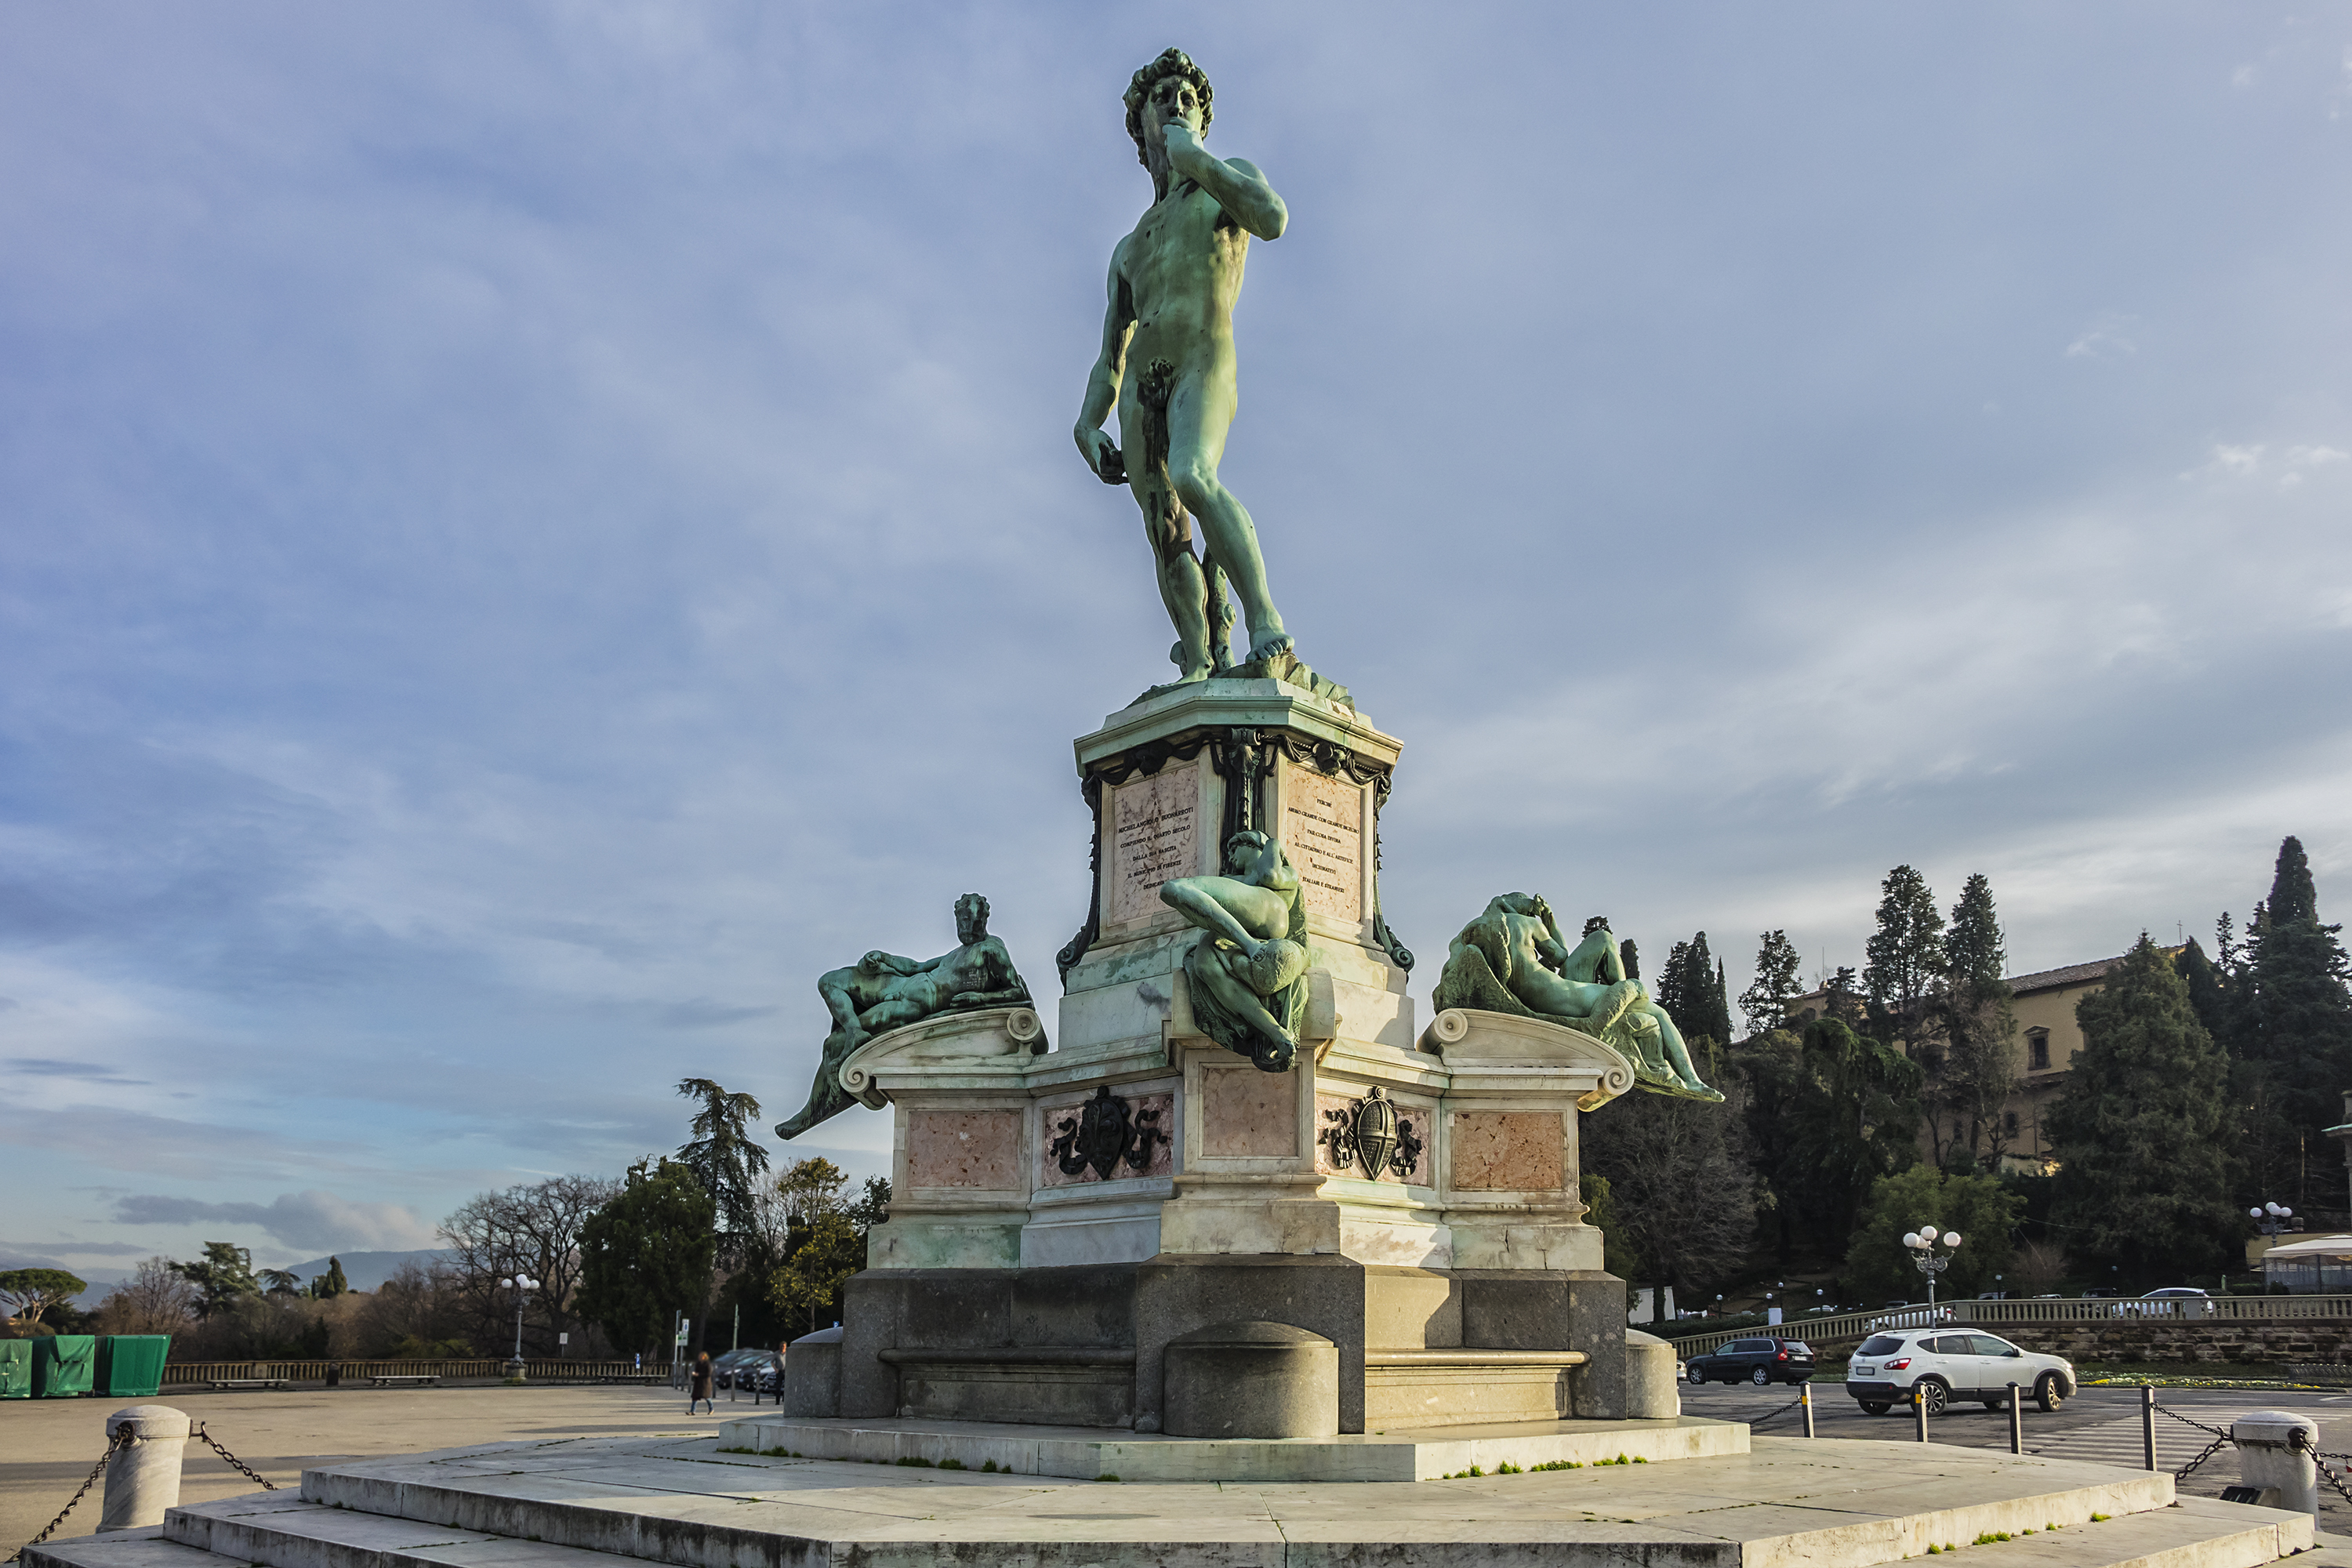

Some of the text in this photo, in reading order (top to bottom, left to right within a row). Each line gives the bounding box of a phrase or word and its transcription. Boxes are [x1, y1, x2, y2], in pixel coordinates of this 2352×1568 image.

[1161, 807, 1193, 821] BUONARROTI
[1302, 811, 1317, 820] GRANDE
[1327, 820, 1342, 829] GRANDE
[1343, 825, 1359, 834] INGEGNO
[1120, 837, 1146, 848] COMPIENDO
[1153, 831, 1171, 840] QUARTO
[1172, 825, 1190, 834] SECOLO
[1301, 844, 1322, 854] CITTADINO
[1335, 855, 1353, 864] ARTEFICE
[1134, 867, 1156, 877] MUNICIPIO
[1163, 860, 1182, 869] FIRENZE
[1312, 863, 1336, 874] INCHINATEVI
[1144, 880, 1165, 890] DEDICAVA
[1302, 877, 1320, 886] ITALIANI
[1325, 883, 1344, 893] STRANIERI
